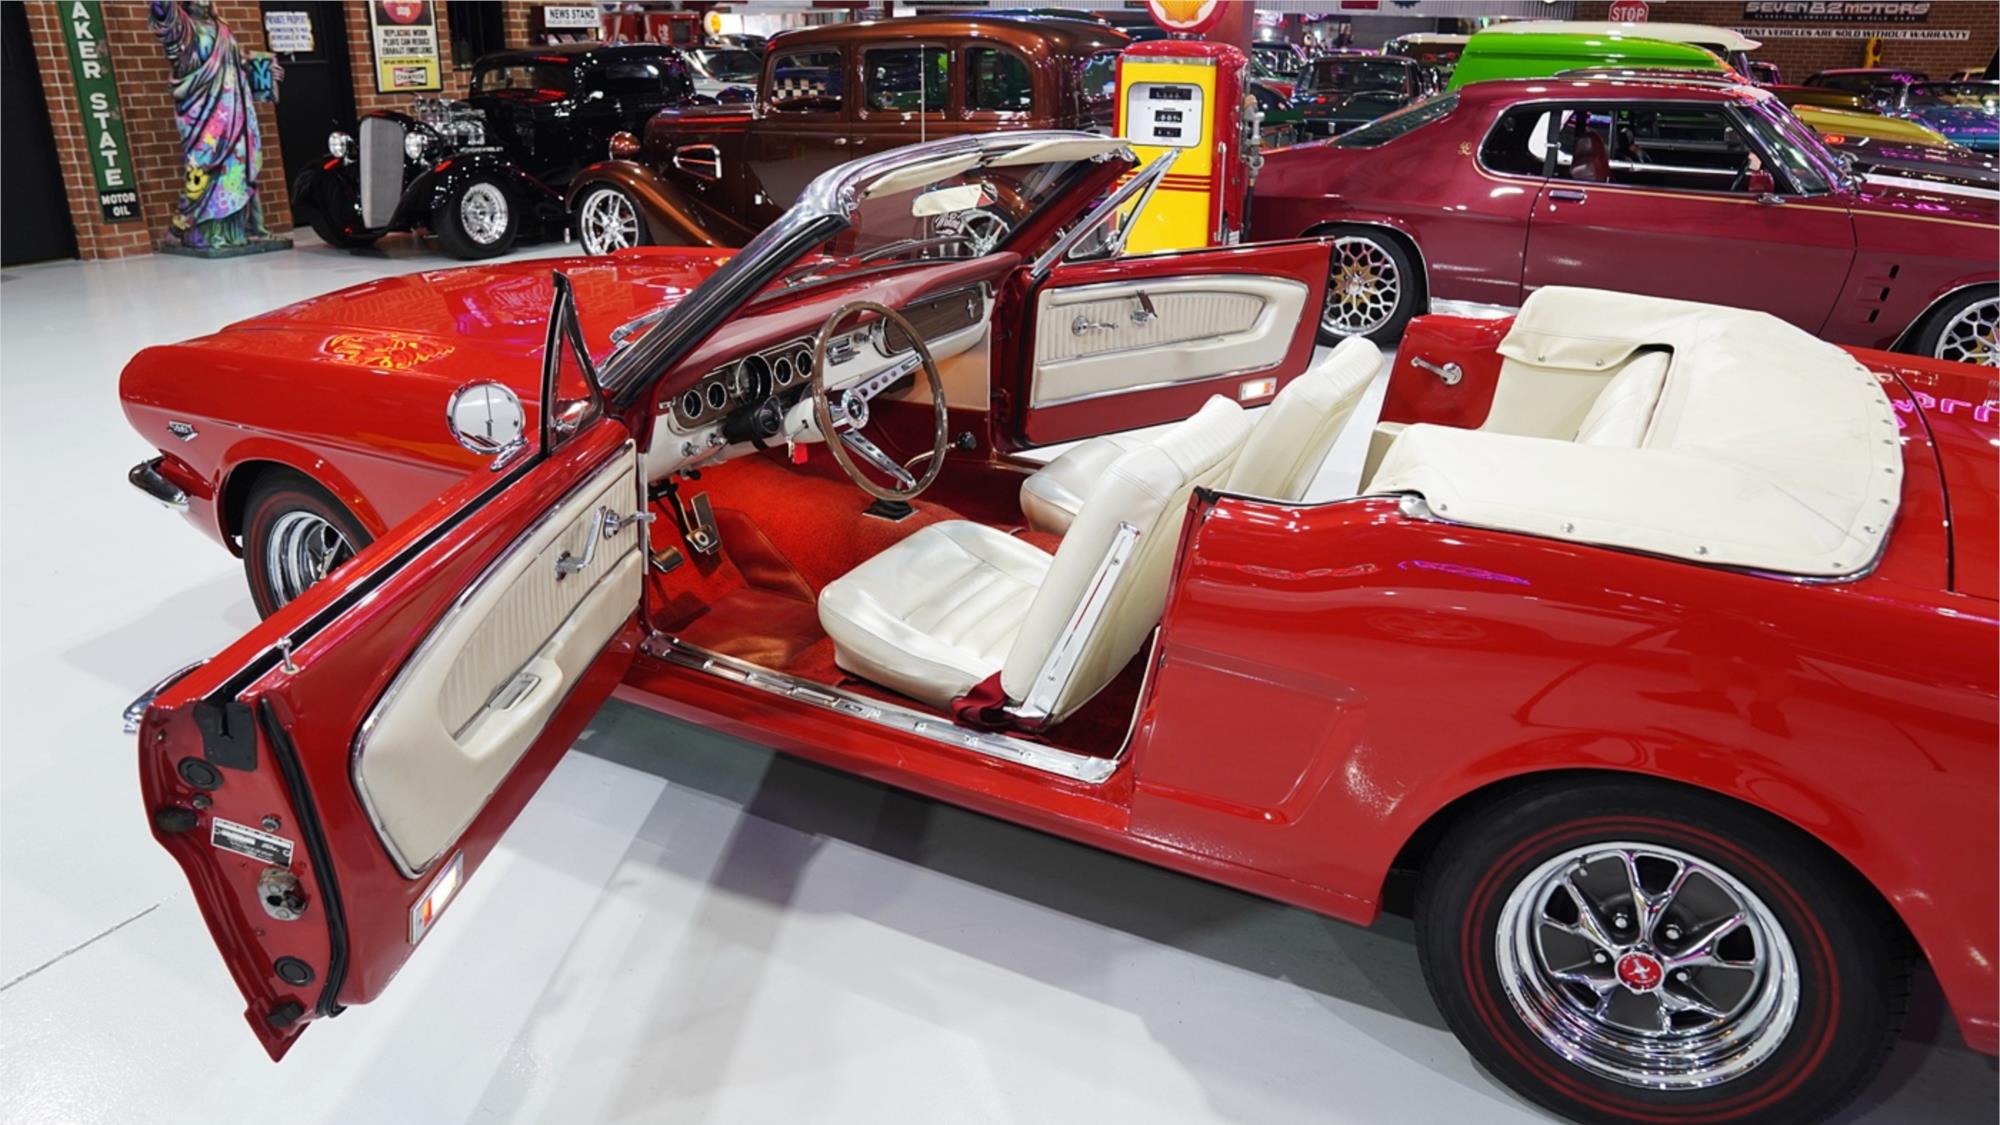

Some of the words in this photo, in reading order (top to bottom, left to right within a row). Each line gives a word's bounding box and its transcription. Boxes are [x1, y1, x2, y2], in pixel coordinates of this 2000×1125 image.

[550, 9, 569, 19] NEWS
[572, 9, 595, 19] STAND
[1611, 7, 1646, 22] STOP
[1767, 28, 1812, 36] VEHICLES
[1814, 29, 1832, 37] ARE
[1835, 29, 1861, 37] SOLD
[1861, 30, 1907, 38] WITHOUT
[1909, 30, 1968, 39] WARRANTY
[90, 93, 124, 186] STATE
[101, 192, 136, 205] MOTOR
[112, 206, 131, 217] OIL
